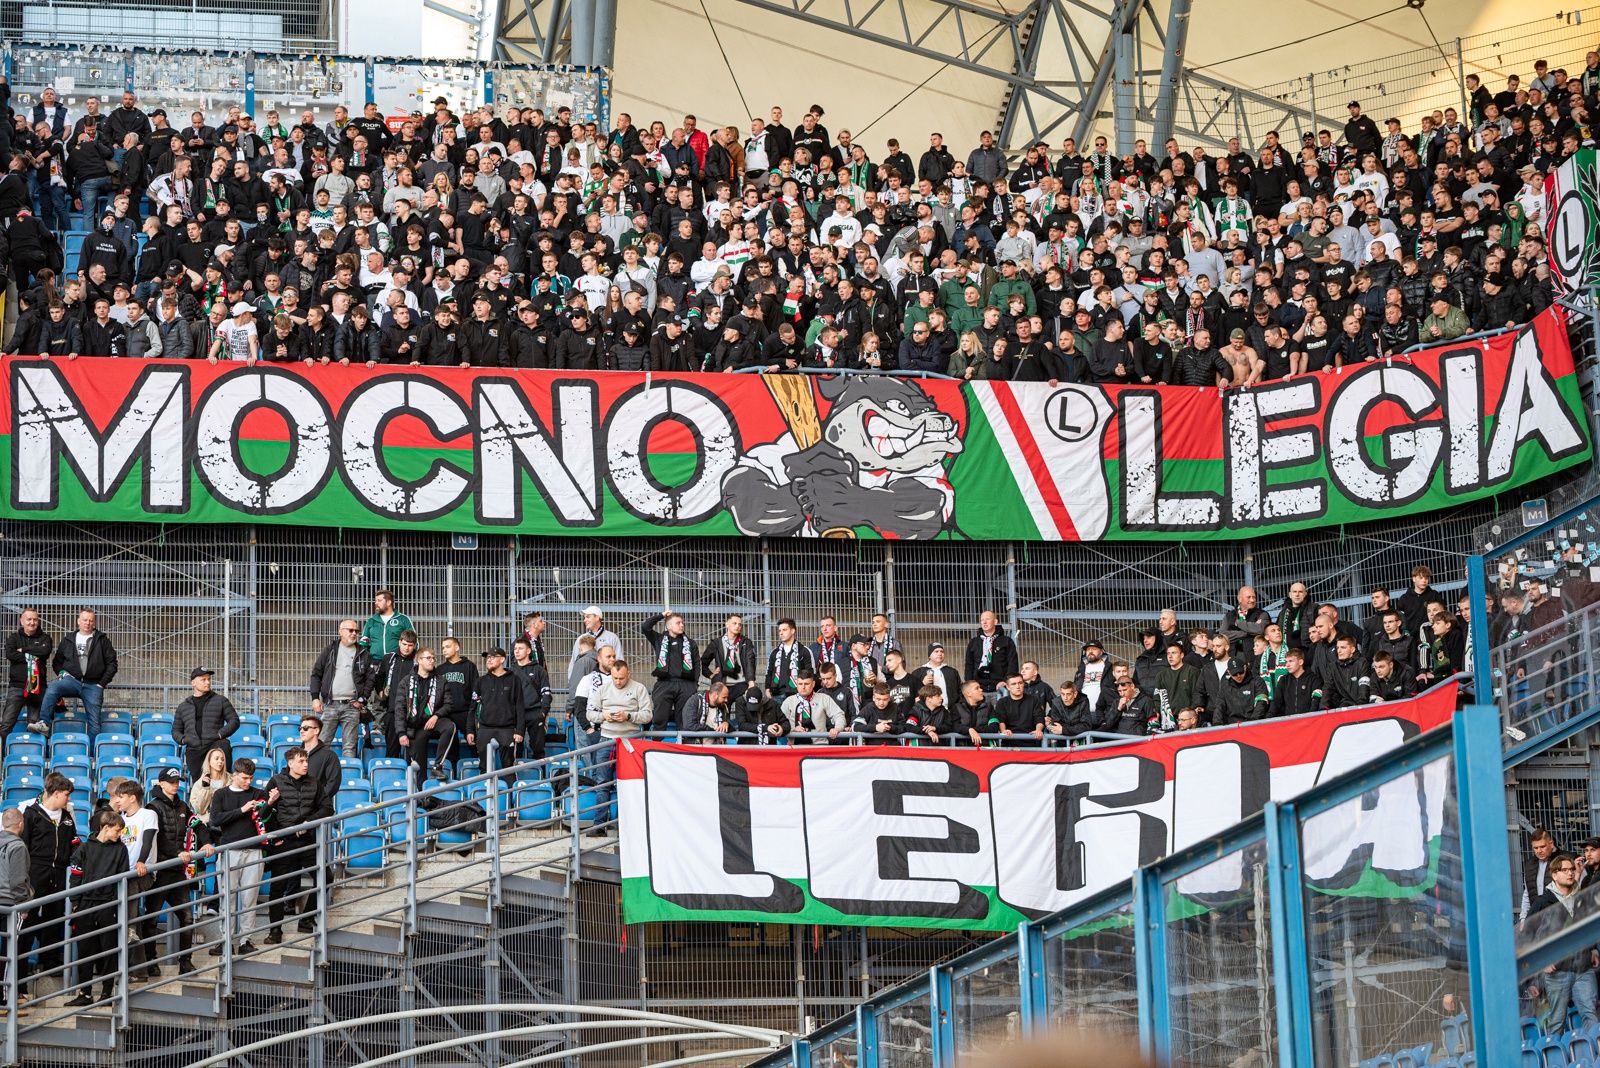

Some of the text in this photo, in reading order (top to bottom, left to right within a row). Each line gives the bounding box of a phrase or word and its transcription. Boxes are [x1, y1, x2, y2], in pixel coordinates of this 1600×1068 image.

[1562, 210, 1580, 263] L
[10, 360, 742, 526] MOCNO
[1117, 327, 1588, 532] LEGIA
[458, 535, 472, 544] N1
[1527, 510, 1543, 520] M1
[442, 671, 465, 685] EGIA
[644, 717, 1432, 921] LEGIA
